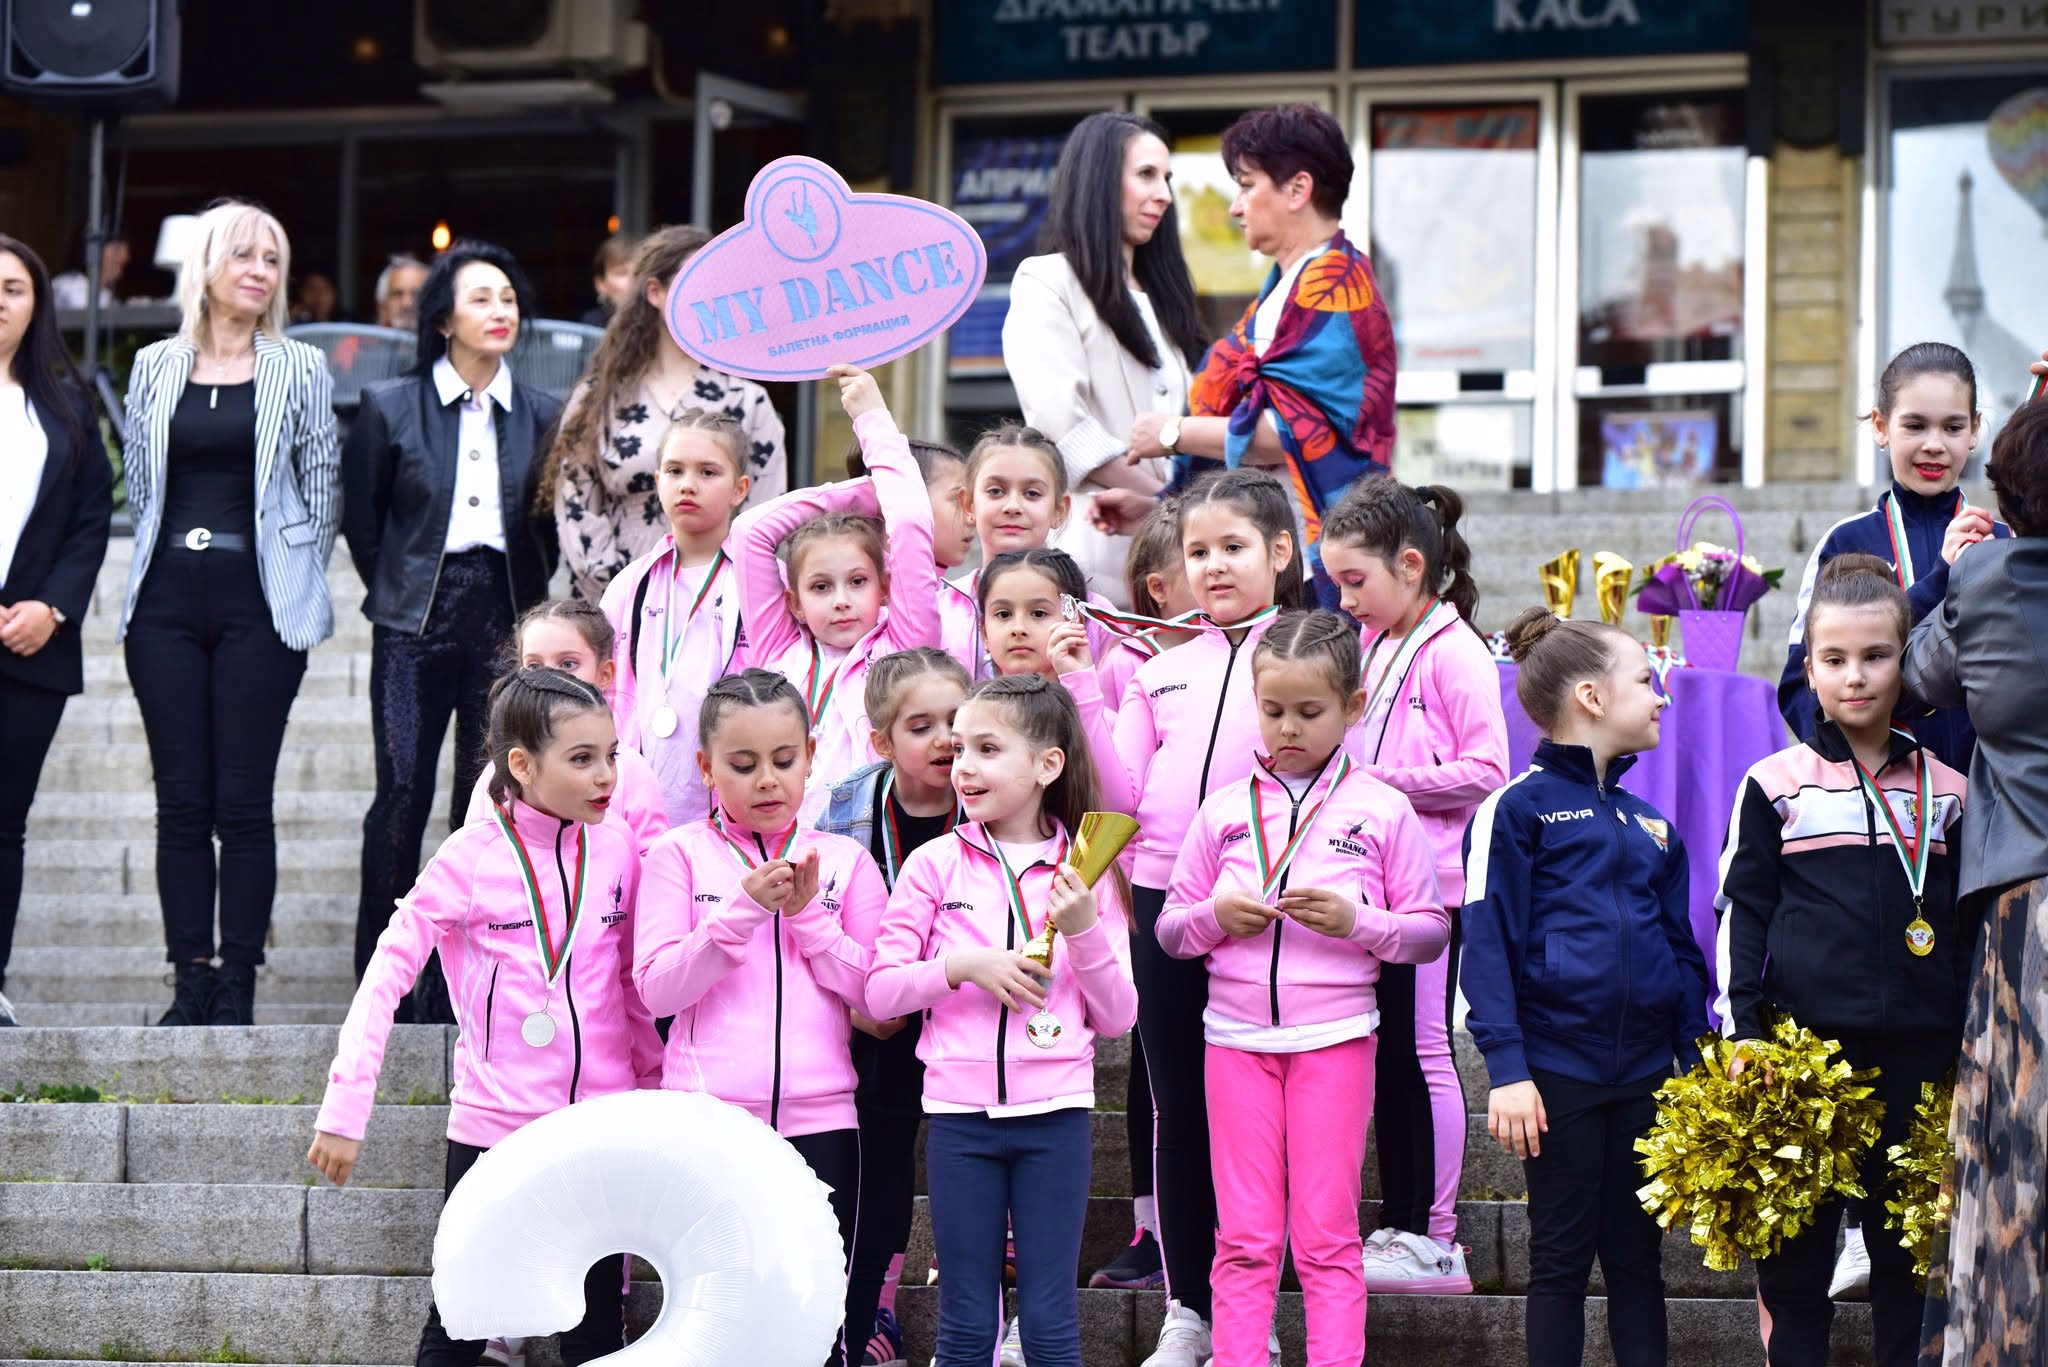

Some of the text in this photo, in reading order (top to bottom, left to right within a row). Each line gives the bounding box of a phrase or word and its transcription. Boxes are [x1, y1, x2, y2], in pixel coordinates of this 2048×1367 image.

[1493, 0, 1641, 33] КАСА
[1889, 3, 2048, 34] ТУРИ
[1061, 22, 1209, 60] ТЕАТЪР
[689, 240, 964, 346] MY DANCE
[767, 314, 910, 357] БАЛЕТНА ФОРМАЦИЯ
[1536, 808, 1594, 824] IVOVA
[1328, 838, 1368, 856] MY DANCE
[694, 893, 722, 903] kras
